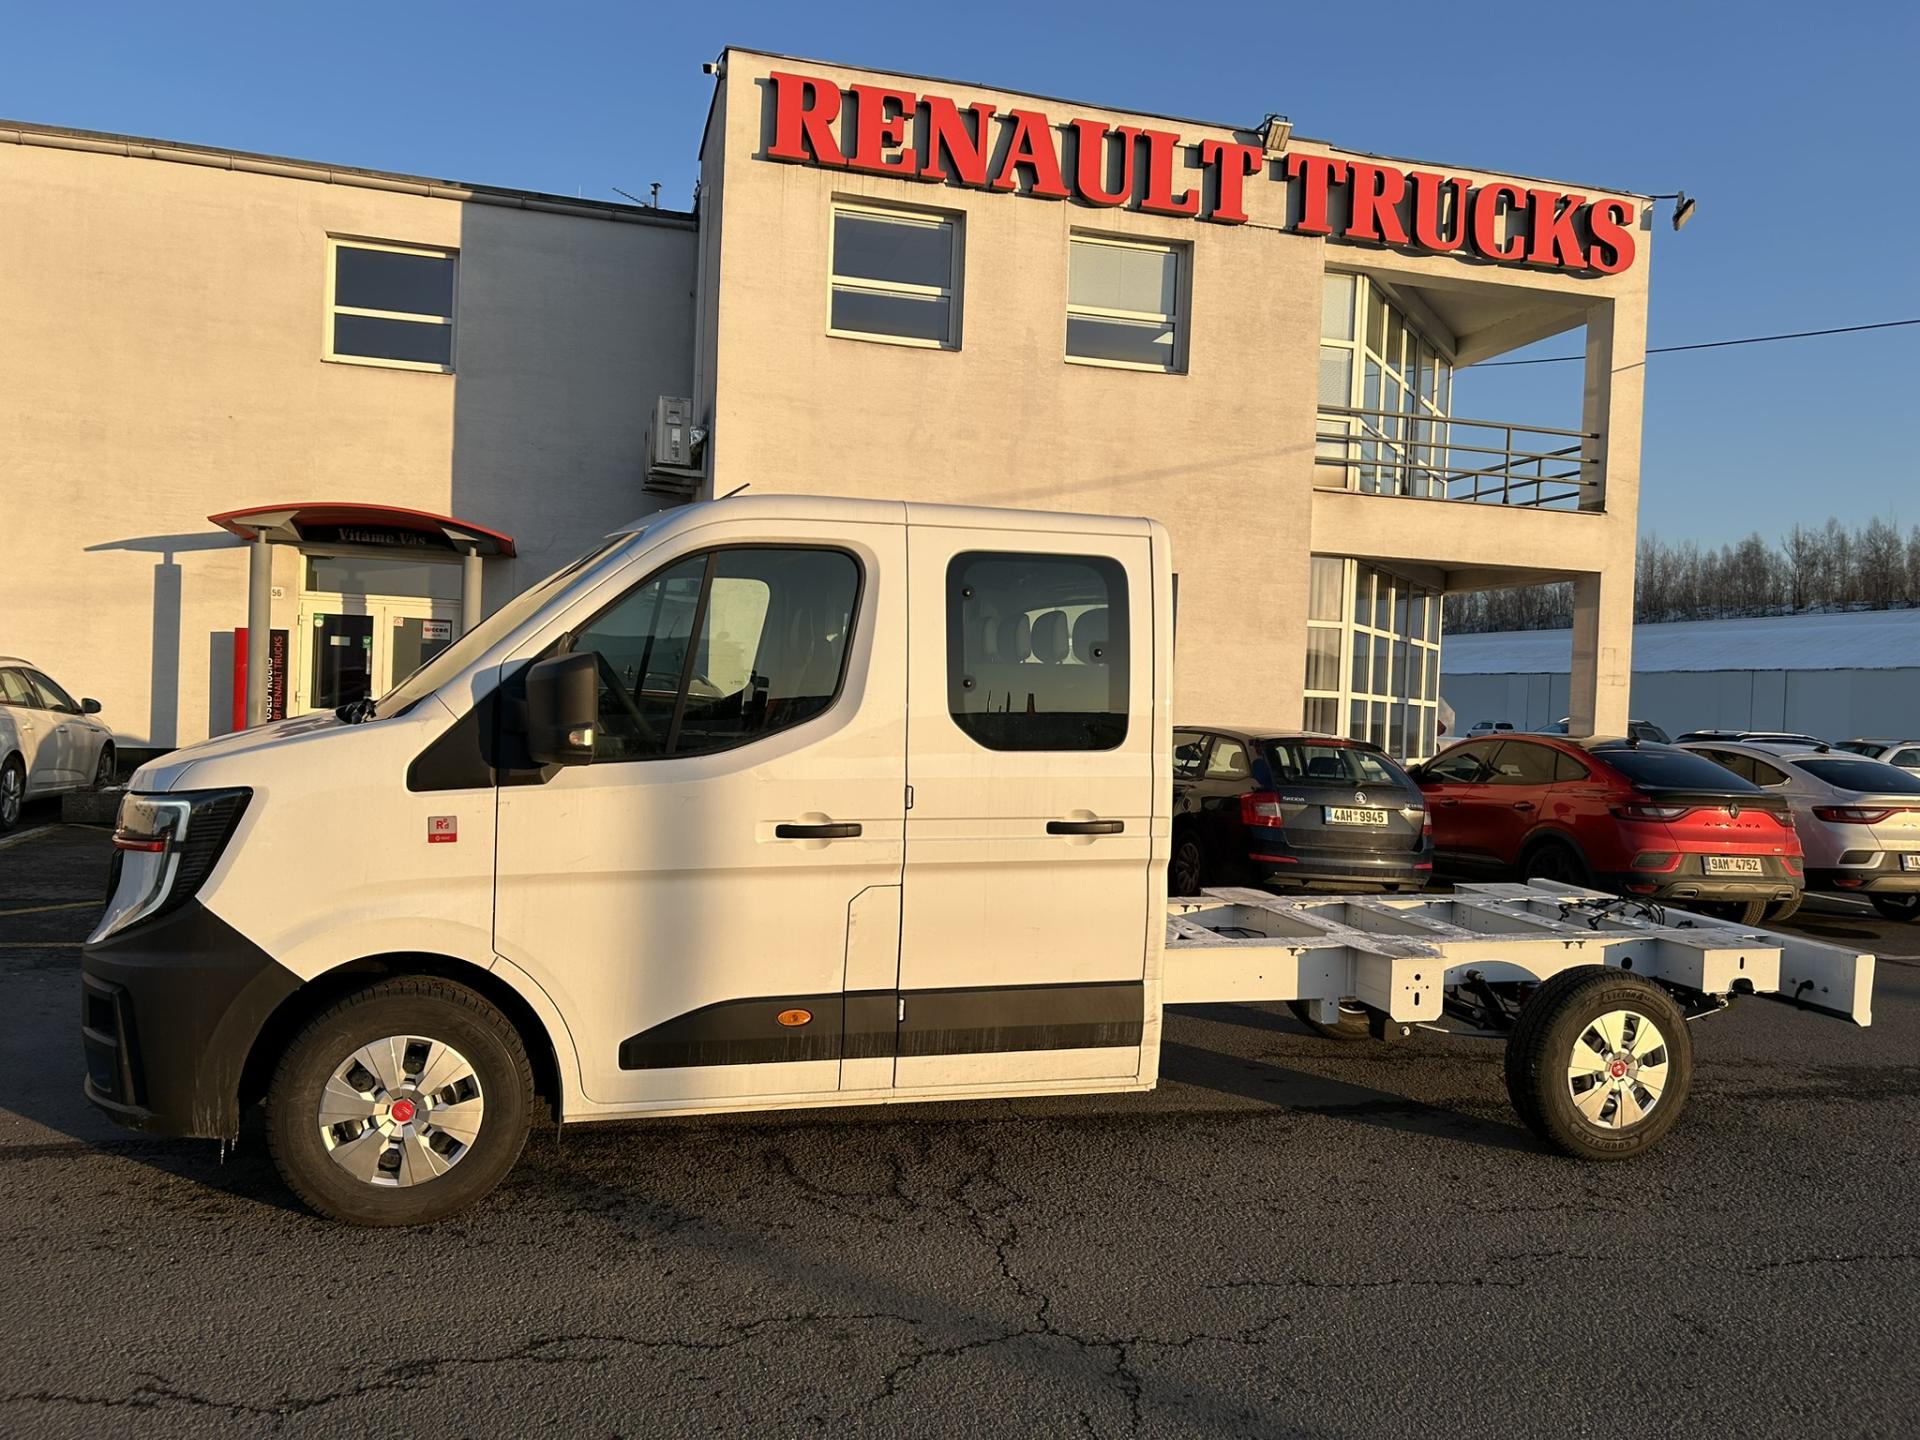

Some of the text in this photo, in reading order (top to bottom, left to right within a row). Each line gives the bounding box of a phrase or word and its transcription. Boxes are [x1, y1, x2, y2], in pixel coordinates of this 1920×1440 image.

[767, 70, 1636, 274] RENAULT TRUCKS
[273, 635, 283, 720] BY RENAULT TRUCKS
[1333, 809, 1384, 823] 4AH 9945
[1711, 858, 1758, 871] 9AM 4752
